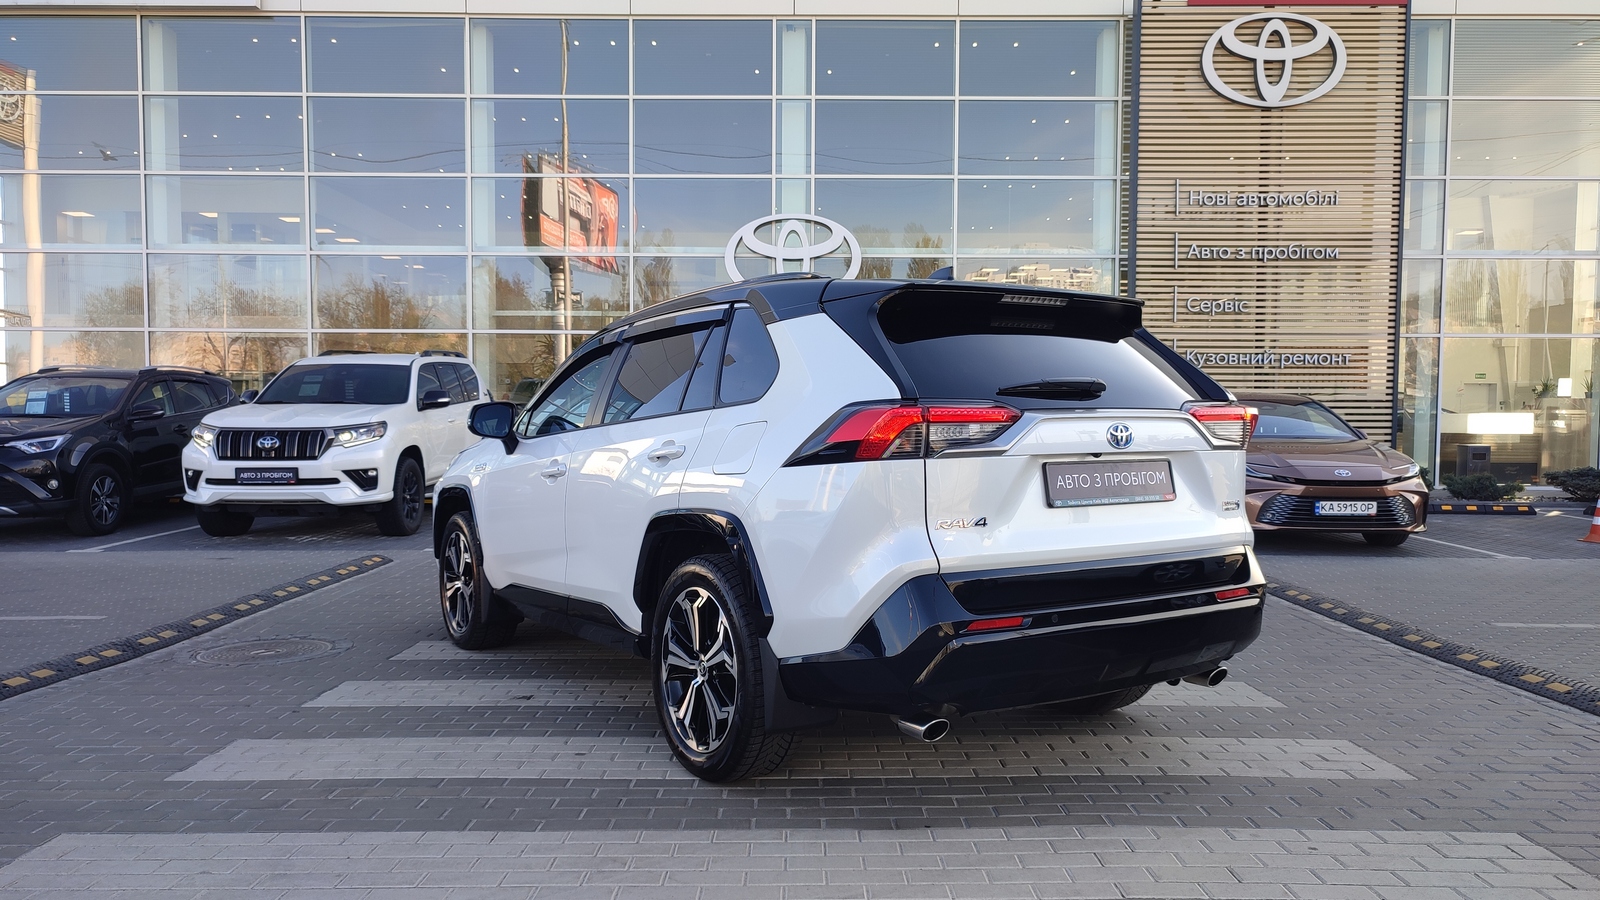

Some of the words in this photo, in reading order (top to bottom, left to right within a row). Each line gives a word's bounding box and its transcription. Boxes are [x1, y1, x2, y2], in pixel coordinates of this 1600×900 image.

[1188, 190, 1231, 206] Нові
[1236, 189, 1340, 206] автомобілі
[1187, 243, 1231, 259] Авто
[1235, 247, 1246, 259] з
[1251, 243, 1339, 263] пробігом
[1186, 297, 1249, 316] Сервіс
[1186, 350, 1275, 368] Кузовний
[1281, 352, 1352, 368] ремонт
[1056, 473, 1091, 489] АВТО
[1094, 473, 1102, 488] З
[1104, 471, 1167, 487] ПРОБІГОМ
[1320, 502, 1334, 512] KA
[1337, 502, 1358, 512] 5915
[1360, 502, 1374, 512] OP
[934, 516, 988, 530] RAV4
